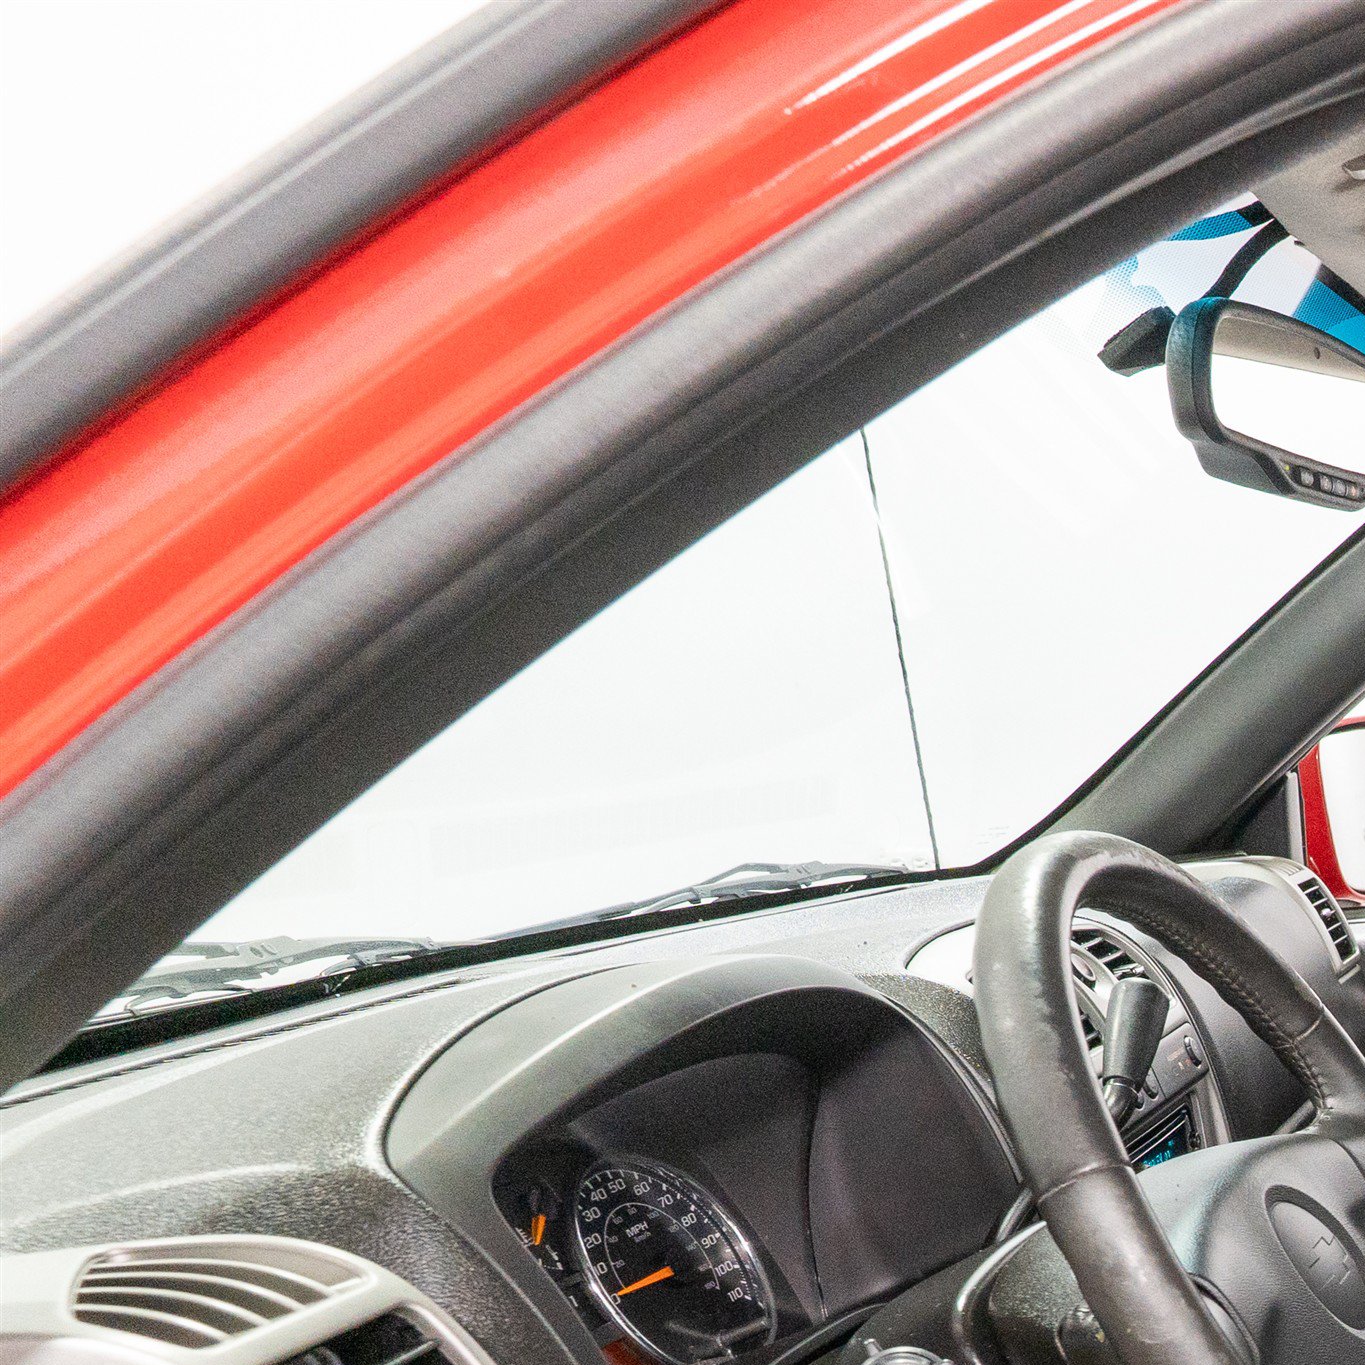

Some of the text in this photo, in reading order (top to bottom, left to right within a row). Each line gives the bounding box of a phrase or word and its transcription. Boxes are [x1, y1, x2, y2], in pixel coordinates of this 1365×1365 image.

[608, 1179, 626, 1193] 50
[633, 1182, 650, 1196] 60
[591, 1188, 607, 1202] 40
[657, 1194, 673, 1207] 70
[582, 1207, 601, 1222] 30
[681, 1213, 697, 1227] 80
[626, 1221, 648, 1238] MPH
[584, 1233, 602, 1248] 20
[701, 1235, 717, 1249] 90
[715, 1261, 733, 1276] 100
[728, 1286, 744, 1302] 110
